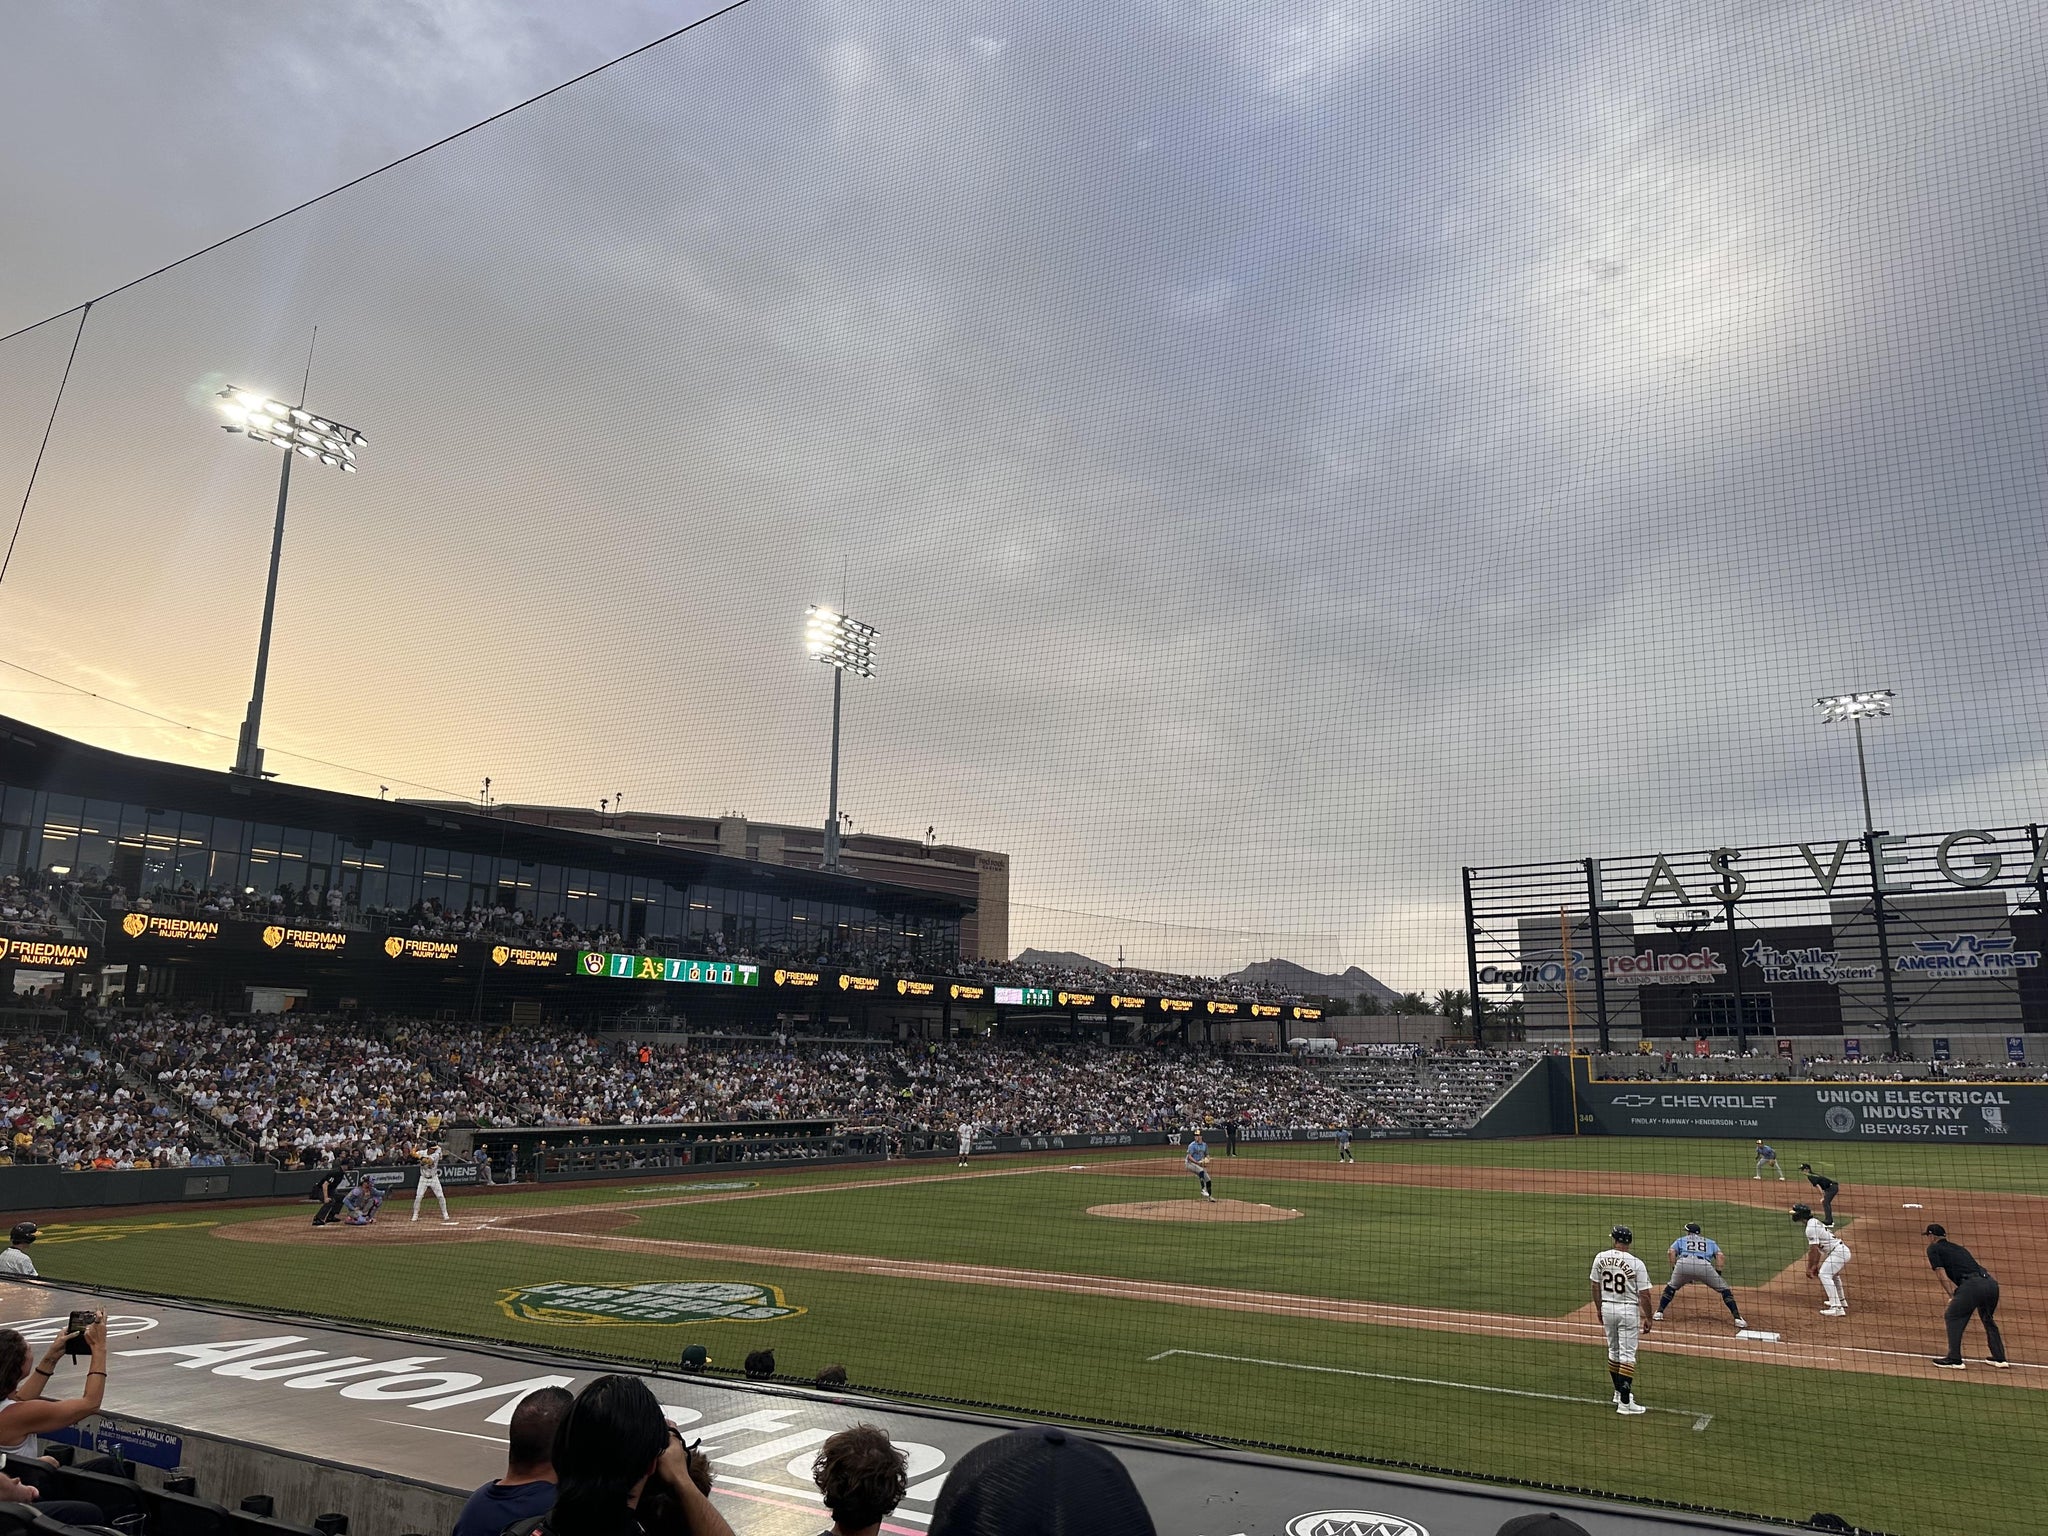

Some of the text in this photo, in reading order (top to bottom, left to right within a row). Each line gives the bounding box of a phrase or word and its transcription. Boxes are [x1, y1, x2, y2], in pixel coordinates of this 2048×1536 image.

[1592, 847, 1746, 907] LAS
[149, 917, 218, 934] FRIEDMAN
[159, 929, 207, 940] INJURY LAW
[286, 929, 346, 944] FRIEDMAN
[10, 941, 88, 959] FRIEDMAN
[294, 940, 337, 950] INJURY LAW
[405, 940, 458, 954] FRIEDMAN
[20, 954, 75, 966] INJURY LAW
[412, 950, 435, 958] INJURY
[510, 949, 557, 961] FRIEDMAN
[1609, 949, 1720, 972] red rock
[618, 957, 628, 974] 1
[637, 957, 664, 979] A's
[672, 961, 681, 979] 1
[691, 970, 699, 979] 0
[1898, 953, 2039, 970] AMERICA FIRST
[786, 972, 819, 981] FRIEDMAN
[1766, 967, 1821, 982] Health
[1930, 968, 2008, 977] CREDIT UNION
[849, 976, 879, 986] FRIEDMAN
[1617, 975, 1714, 984] CASINO RESORT SPA
[907, 982, 934, 991] FRIEDMAN
[1506, 984, 1561, 992] BANK
[1661, 1095, 1777, 1108] CHEVROLET
[1816, 1090, 2011, 1105] UNION ELECTRICAL
[1579, 1114, 1594, 1122] 340
[1862, 1106, 1963, 1119] INDUSTRY
[1694, 1118, 1734, 1126] HENDERSON
[1739, 1119, 1758, 1127] TEAM
[1241, 1130, 1293, 1140] HANRATTY
[1860, 1123, 1968, 1136] IBEW357.NET
[443, 1166, 477, 1177] WIENS
[1686, 1240, 1707, 1253] 28
[1602, 1270, 1626, 1294] 28
[137, 1429, 146, 1437] OR
[146, 1430, 164, 1443] WALK
[165, 1435, 177, 1445] ON!
